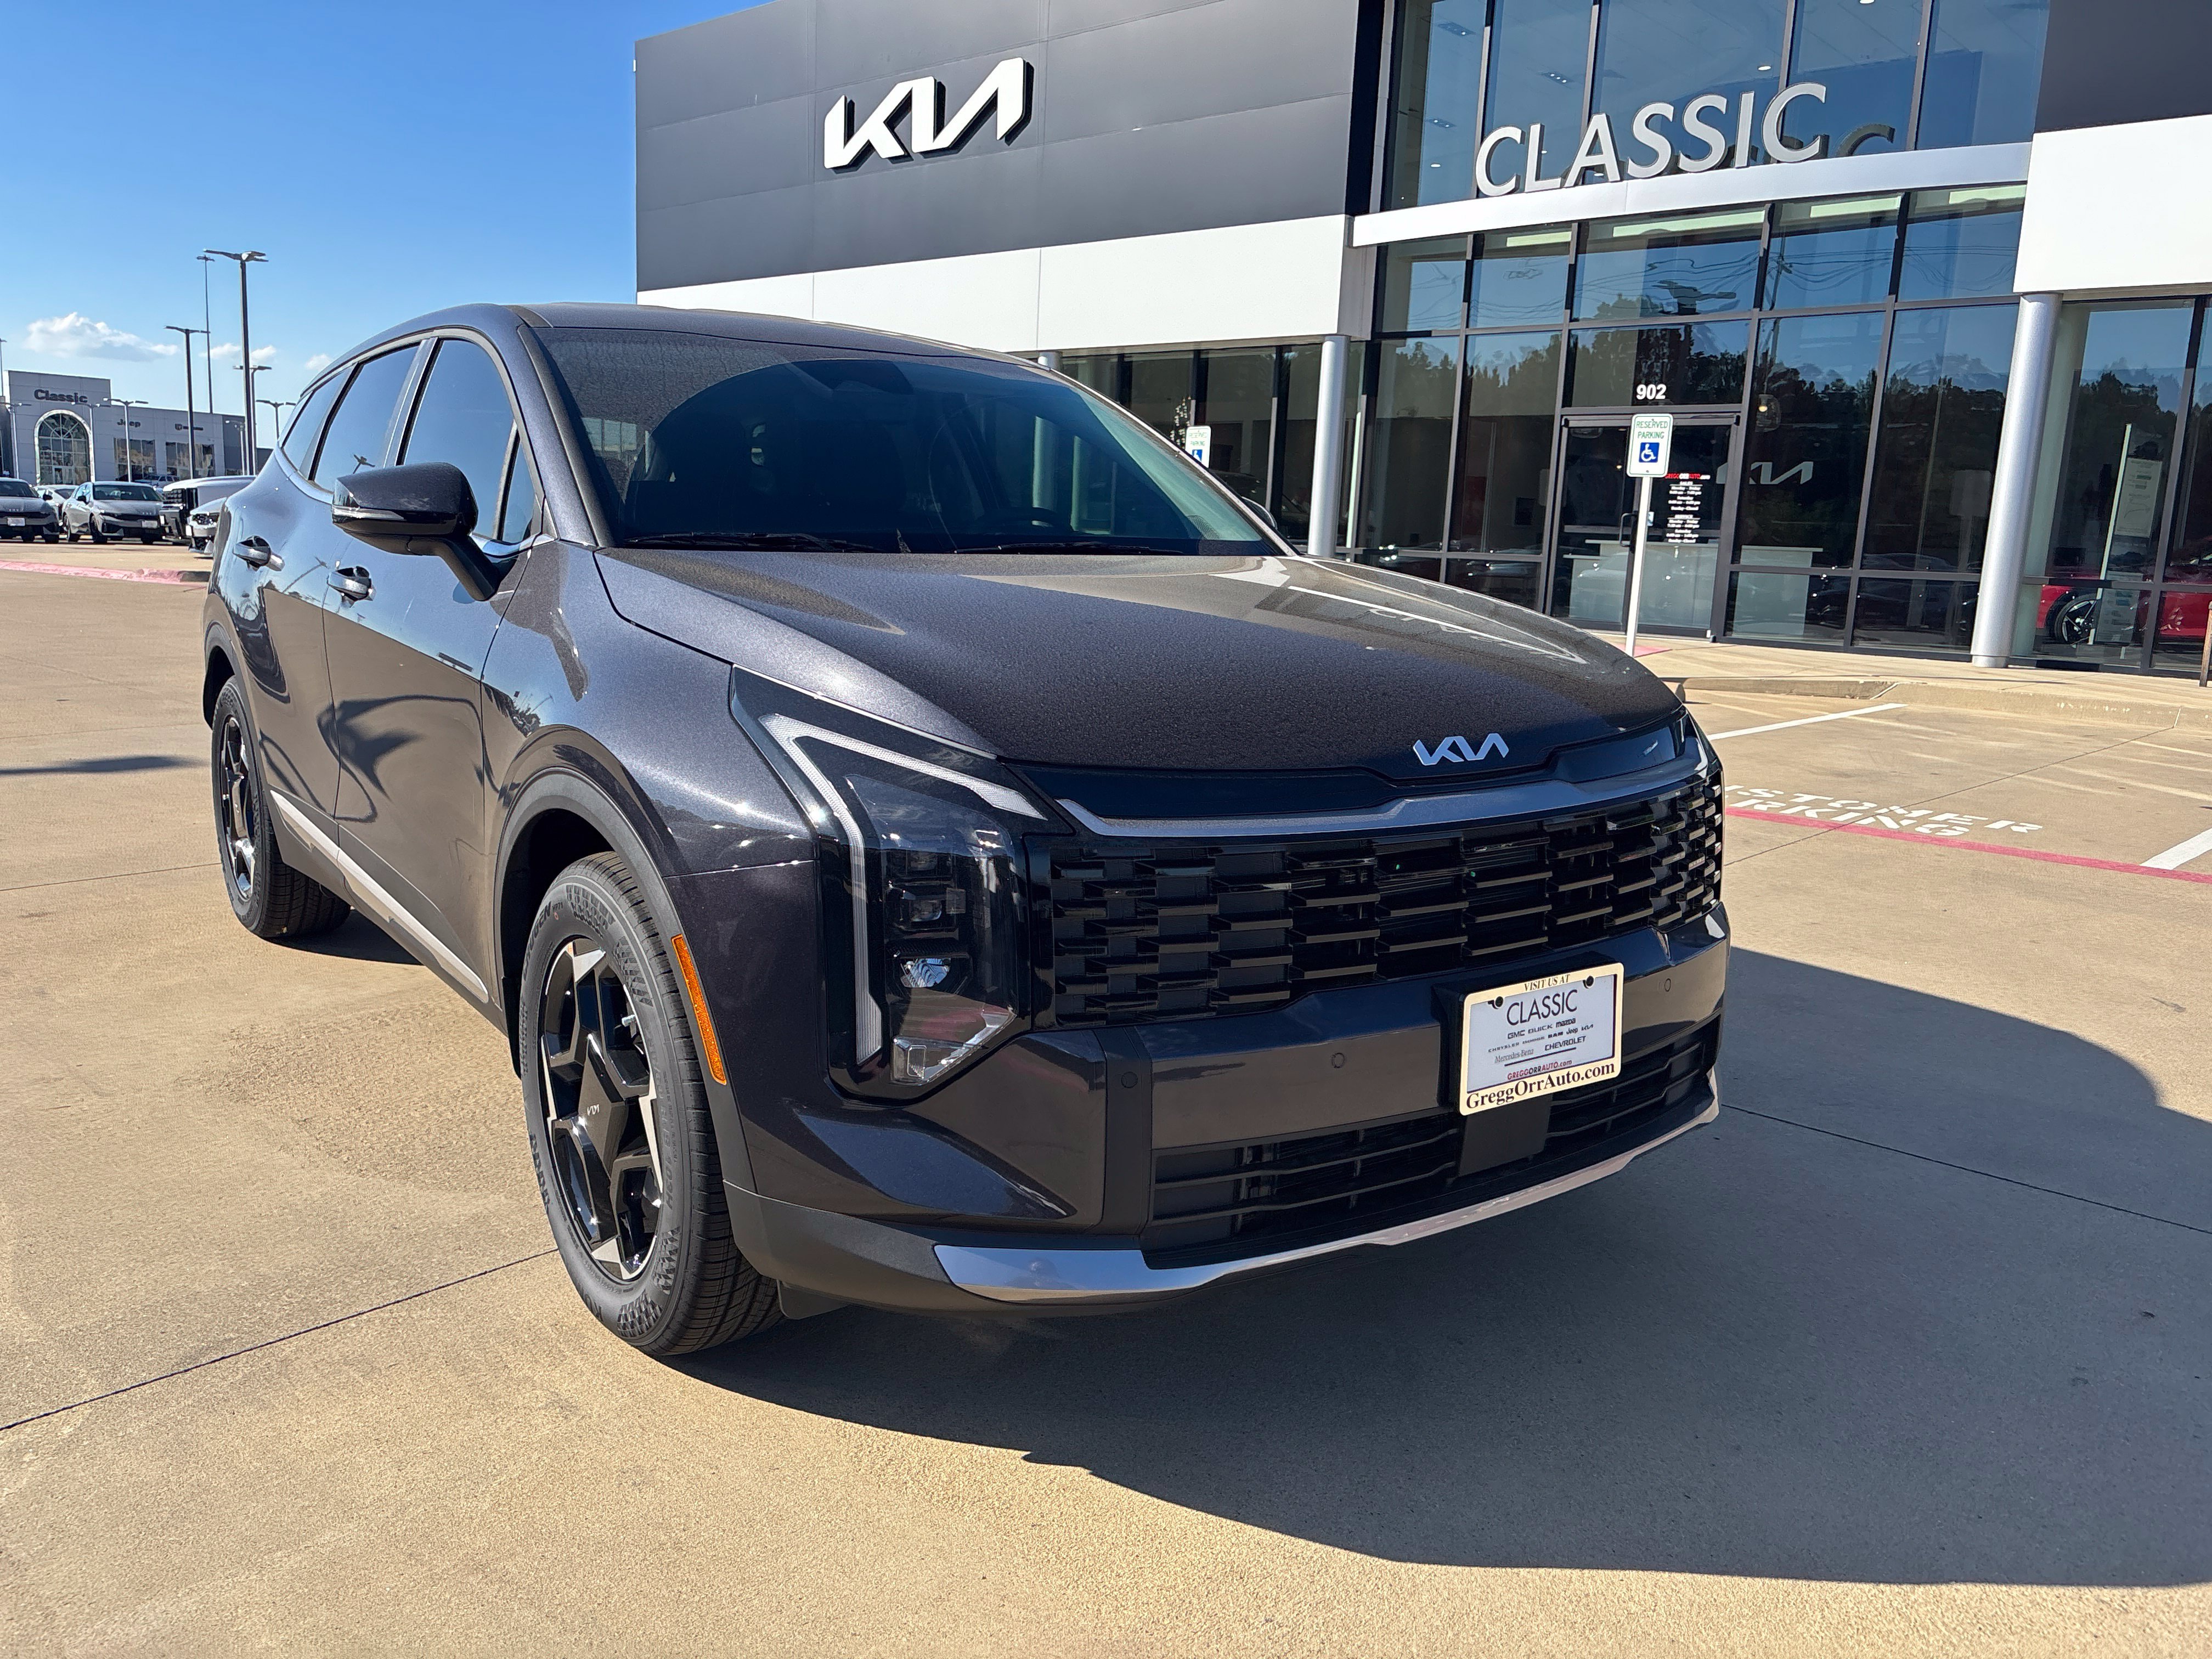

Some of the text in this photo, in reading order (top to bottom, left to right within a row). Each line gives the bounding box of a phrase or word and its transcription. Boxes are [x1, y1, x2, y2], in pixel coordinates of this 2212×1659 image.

[824, 57, 1025, 169] KIA
[1475, 82, 1826, 196] CLASSIC
[34, 389, 88, 403] Classic
[1637, 384, 1667, 399] 902
[1413, 733, 1509, 766] KIA
[1725, 785, 2043, 833] STOMER
[1726, 795, 1970, 836] RKING
[1524, 974, 1571, 991] VISIT US AT
[1507, 989, 1578, 1025] CLASSIC
[1508, 1030, 1526, 1039] GMC
[1528, 1024, 1553, 1034] BUICK
[1488, 1042, 1520, 1052] CHRYSLER
[1494, 1036, 1587, 1063] Mercedes-Benz CHEVROLET
[1507, 1060, 1572, 1080] GREGGORRAUTO.com
[1466, 1063, 1615, 1109] GreggOrrAuto.com
